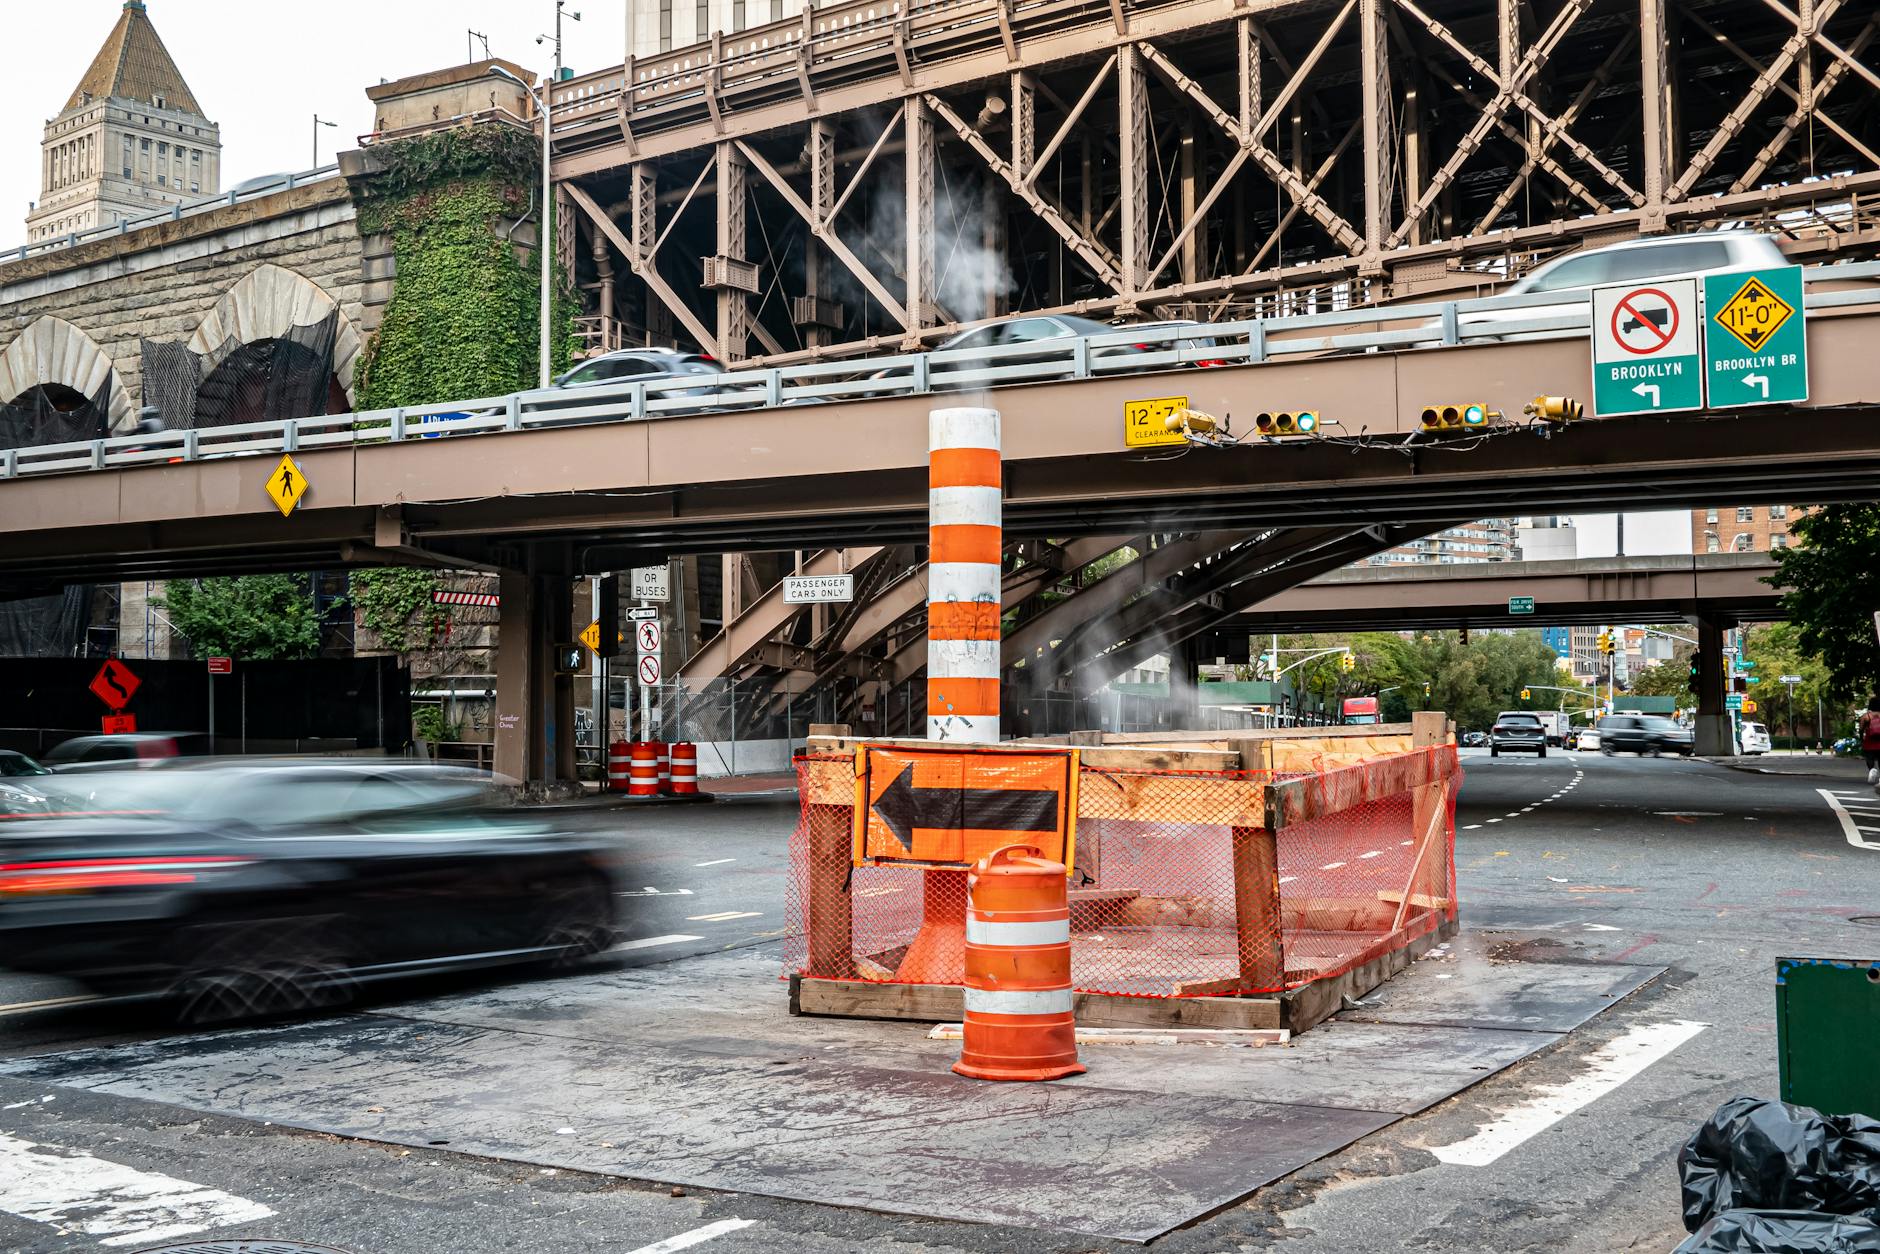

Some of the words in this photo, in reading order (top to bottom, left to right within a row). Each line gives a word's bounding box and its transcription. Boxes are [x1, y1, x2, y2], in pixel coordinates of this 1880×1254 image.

[1715, 356, 1775, 372] BROOKLYN
[1781, 353, 1797, 366] BR
[1611, 362, 1682, 381] BROOKLYN
[1135, 429, 1180, 439] CLEARAN
[644, 573, 657, 583] OR
[790, 579, 846, 589] PASSENGER
[635, 585, 666, 597] BUSES
[791, 590, 816, 598] CARS
[821, 589, 844, 597] ONLY
